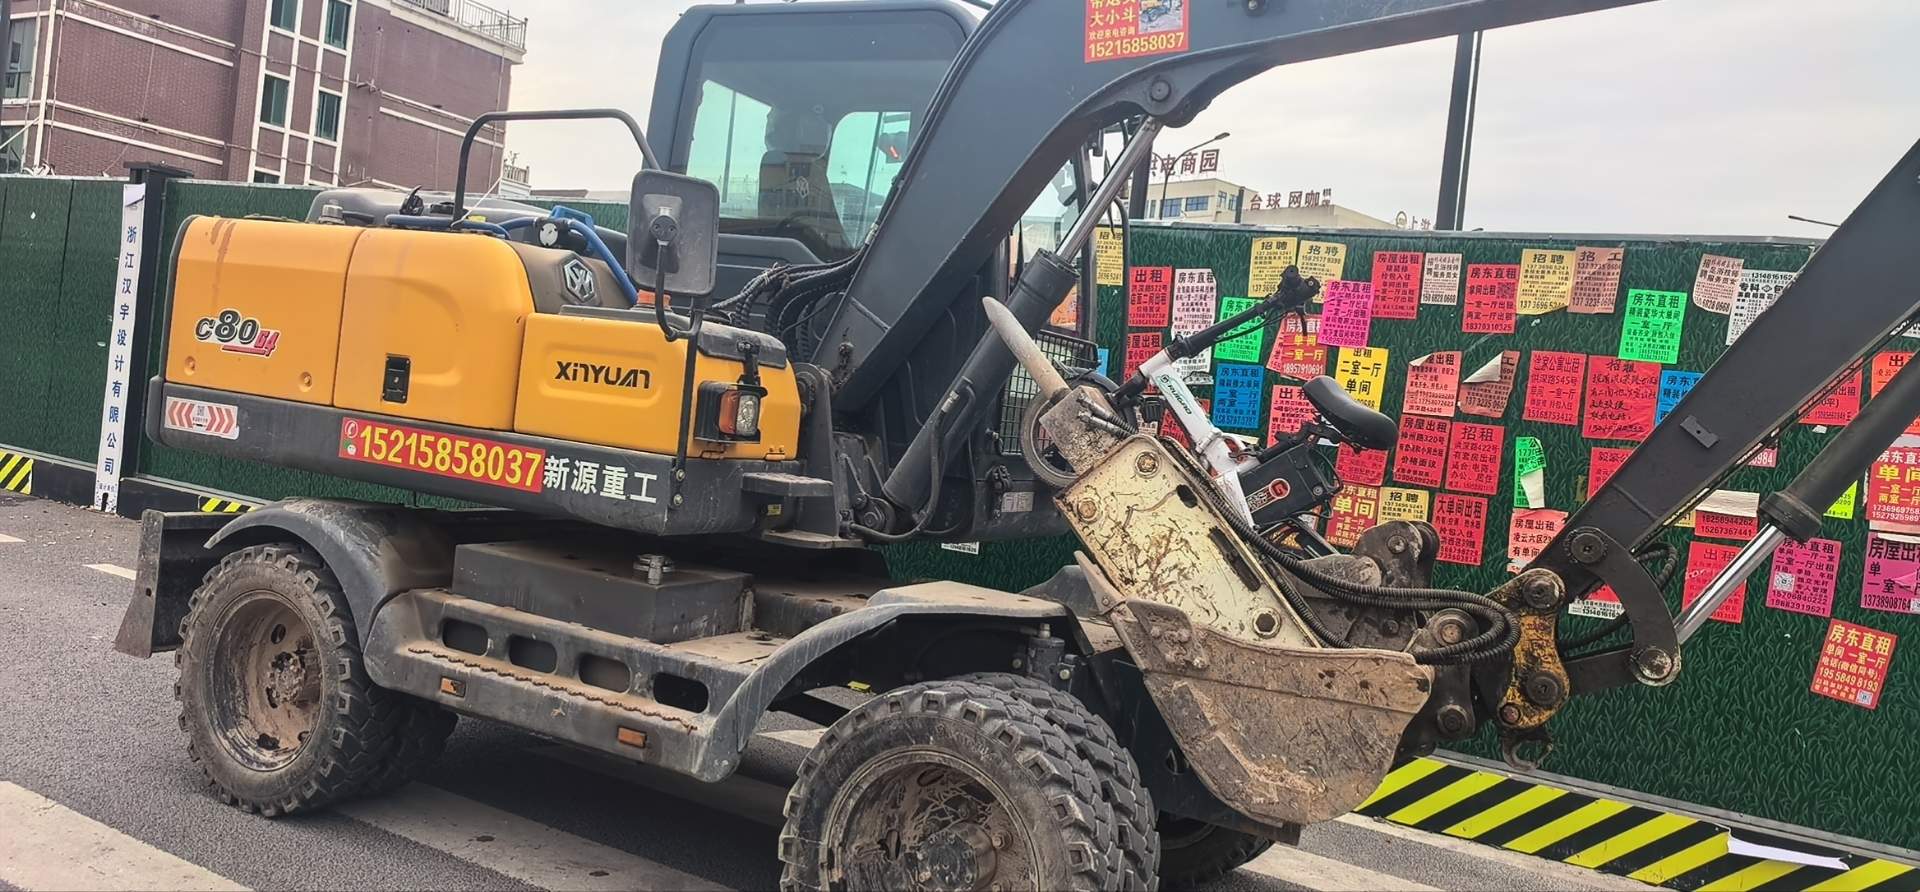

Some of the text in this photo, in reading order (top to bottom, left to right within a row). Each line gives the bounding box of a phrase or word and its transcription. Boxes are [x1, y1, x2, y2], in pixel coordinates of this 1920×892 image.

[1089, 7, 1136, 28] 大小斗
[1088, 32, 1185, 58] 15215858037
[1250, 190, 1321, 210] 台球 网咖
[1261, 241, 1288, 251] 招聘
[1307, 244, 1339, 257] 招聘
[1376, 253, 1420, 265] 房屋出租
[1532, 253, 1565, 264] 招聘
[1135, 269, 1163, 283] 出租
[1178, 271, 1214, 284] 房东直租
[1470, 267, 1517, 279] 房东直租
[1330, 280, 1371, 293] 房东直租
[1632, 293, 1680, 309] 房东直租
[1631, 320, 1673, 331] 一室一厅
[1294, 334, 1317, 347] 单间
[104, 226, 137, 476] 浙江汉宇设计有限公司
[1285, 349, 1324, 361] 一室一厅
[1353, 348, 1373, 358] 出租
[1427, 353, 1455, 366] 屋出租
[1221, 367, 1260, 378] 房东直租
[1340, 360, 1382, 378] 二室一厅
[1217, 389, 1257, 400] 一室一厅
[1344, 378, 1371, 396] 单间
[1403, 417, 1448, 434] 房屋出租
[1461, 426, 1494, 442] 招租
[360, 425, 542, 487] 15215858037
[1401, 455, 1437, 469] 价格面议
[1877, 450, 1920, 465] 房东直
[543, 455, 657, 504] 新源重工
[1343, 484, 1377, 499] 东直租
[1389, 491, 1419, 503] 招聘
[1332, 494, 1376, 519] 单间
[1436, 496, 1483, 519] 大单间出租
[1514, 518, 1555, 531] 房屋出租
[1703, 548, 1736, 562] 出租
[1868, 536, 1920, 563] 房屋出
[1775, 555, 1834, 573] 二室一厅出租
[1863, 594, 1911, 612] 13738908764
[1829, 623, 1892, 656] 房东直租
[1824, 642, 1887, 670] 单间 一室一厅
[1819, 667, 1879, 693] 195 5849 8193
